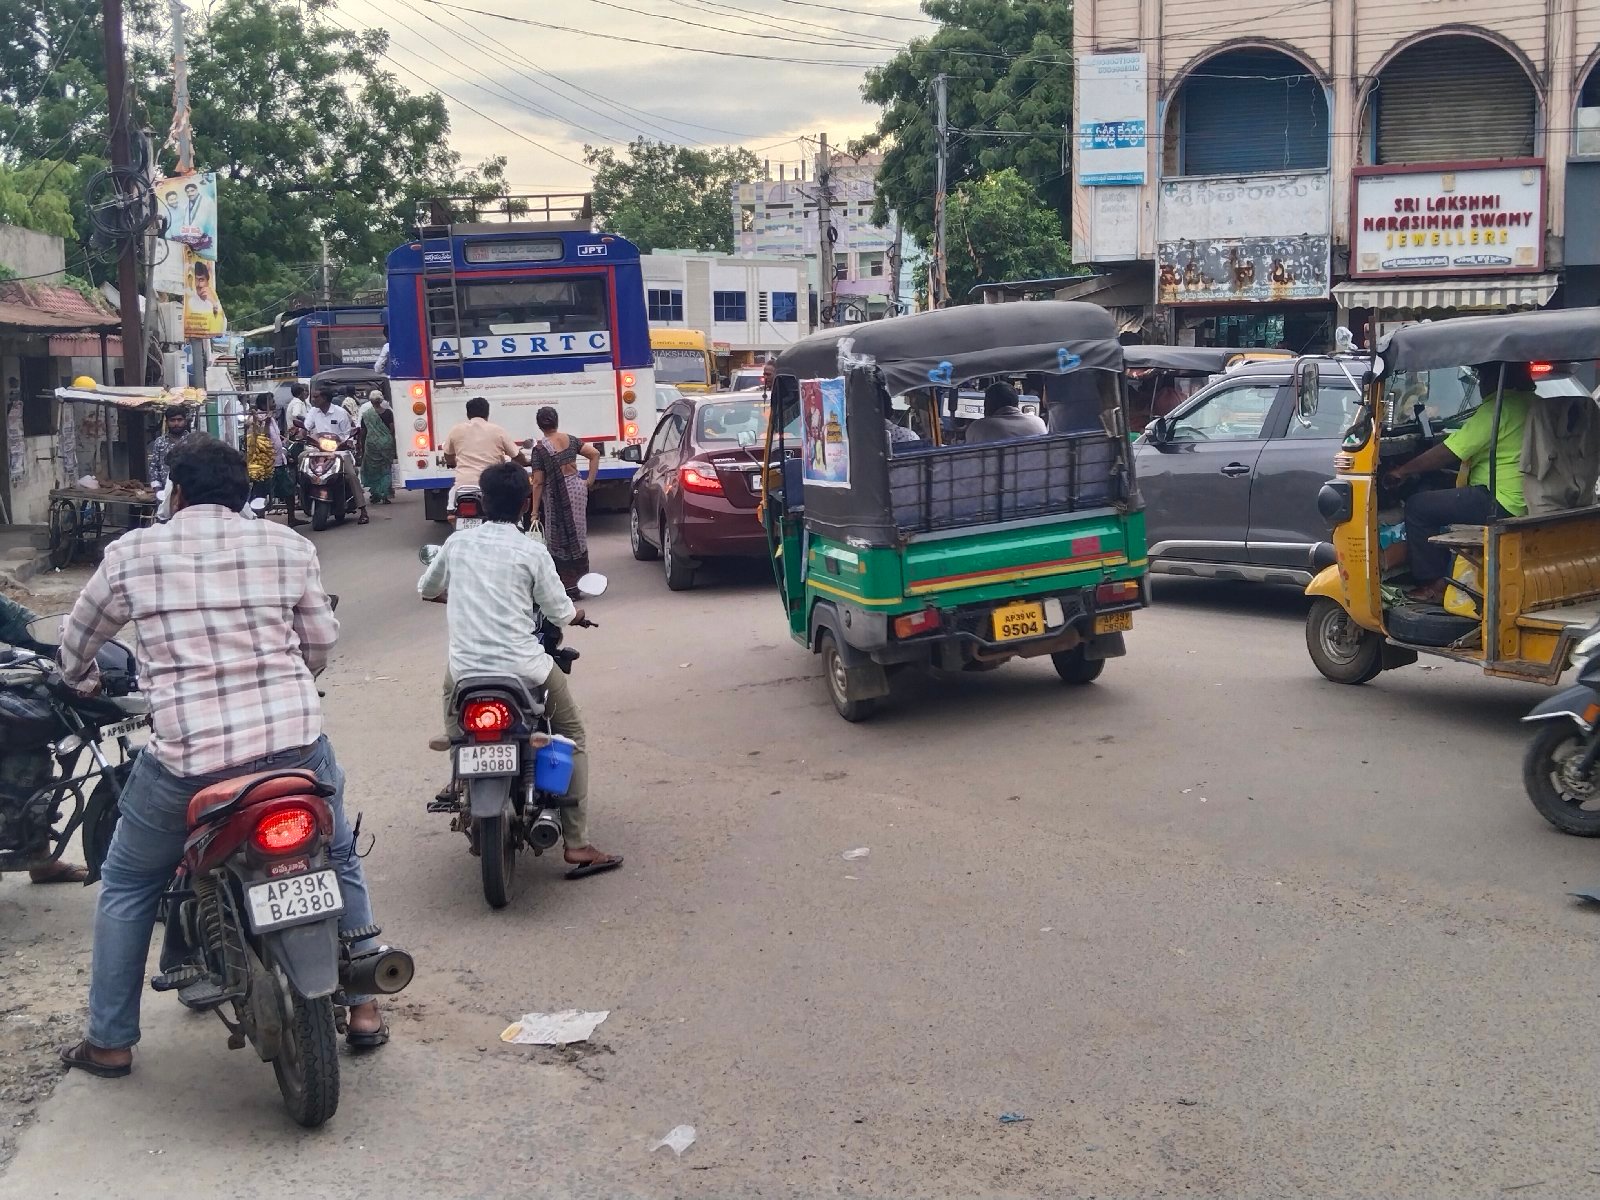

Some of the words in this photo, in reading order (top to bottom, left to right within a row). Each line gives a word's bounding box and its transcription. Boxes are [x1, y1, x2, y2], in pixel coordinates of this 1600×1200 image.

[1395, 198, 1419, 213] SRI
[1427, 194, 1500, 212] LAKSHMI
[1363, 214, 1464, 232] NARASIMHA
[1471, 212, 1533, 228] SWAMY
[1386, 229, 1508, 250] JEWELLERS
[581, 246, 604, 255] JPT
[627, 437, 648, 446] STOP
[1004, 614, 1024, 624] AP39
[1026, 611, 1037, 620] VC
[1002, 622, 1039, 637] 9504
[472, 747, 512, 759] AP39S
[472, 760, 513, 772] J9080
[267, 873, 328, 902] AP39K
[271, 892, 335, 921] B4380
